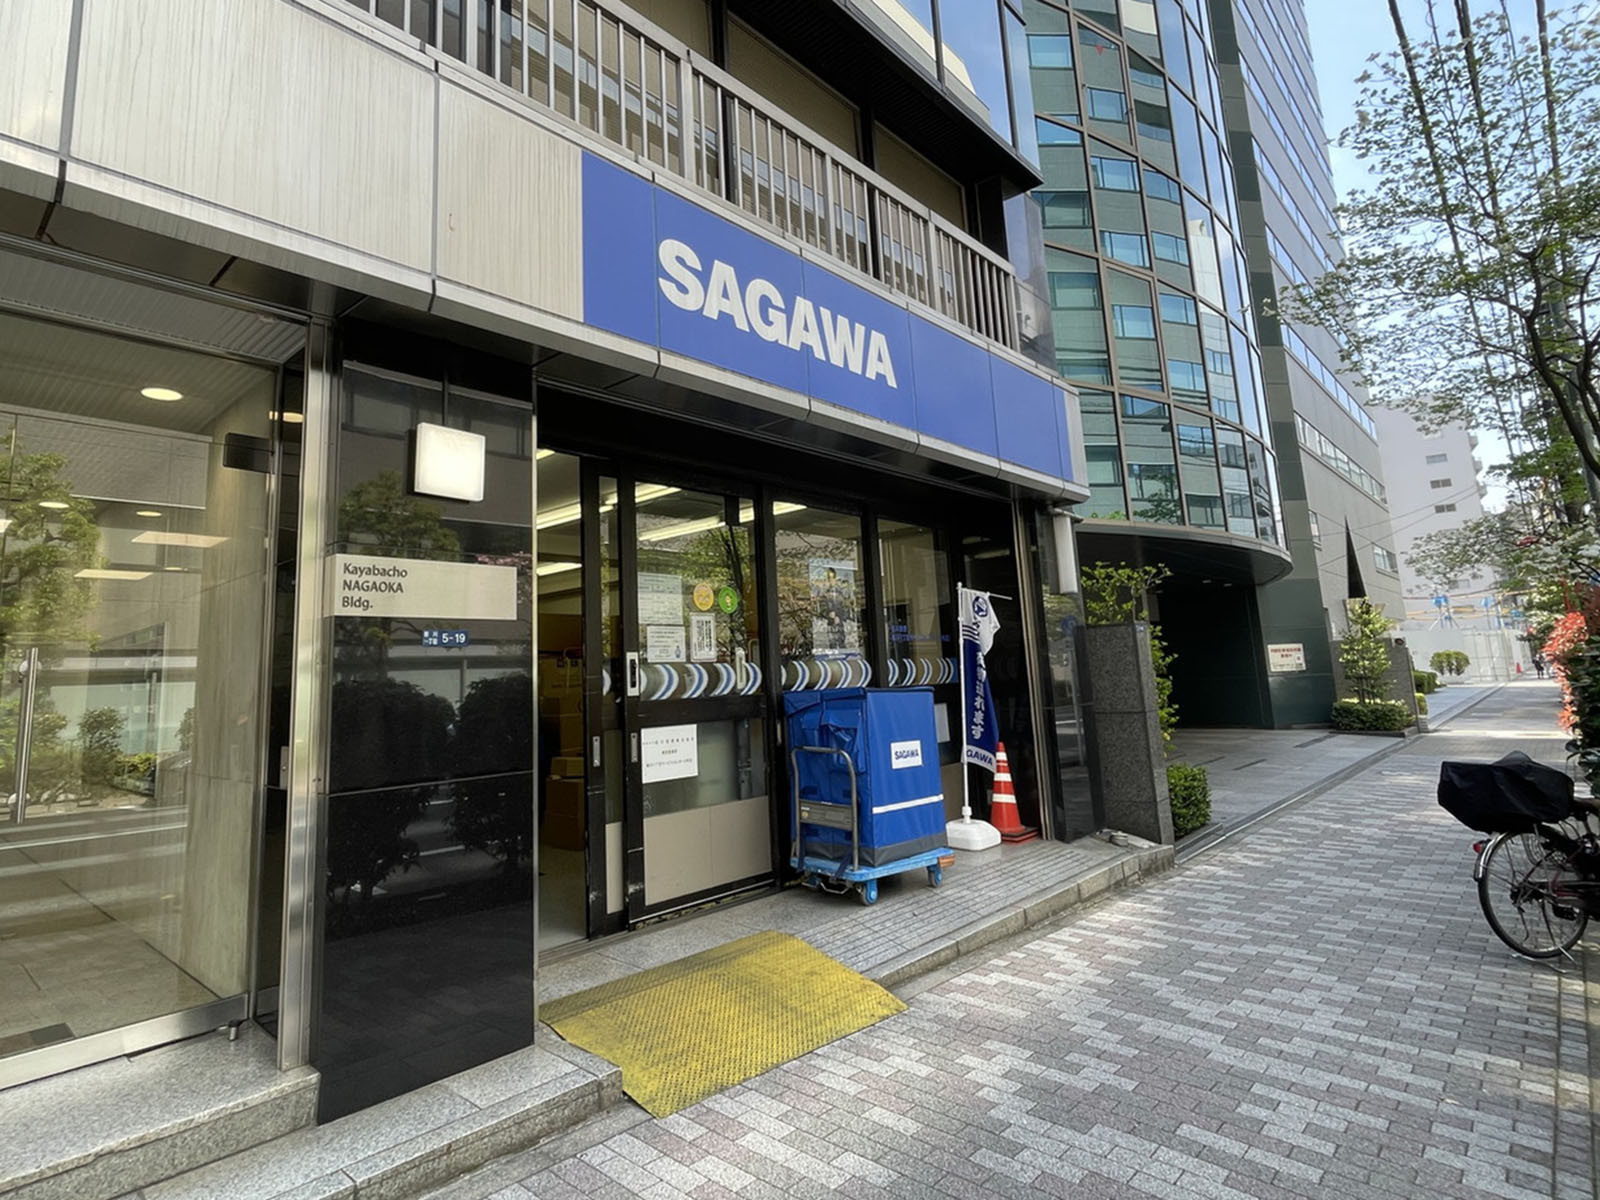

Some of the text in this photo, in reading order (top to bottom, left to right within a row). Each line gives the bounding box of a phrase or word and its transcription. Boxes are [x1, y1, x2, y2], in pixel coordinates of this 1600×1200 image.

[658, 238, 897, 389] SAGAWA
[343, 562, 408, 578] Kayabacho
[342, 579, 404, 594] NAGAOKA
[342, 595, 373, 611] Bldg.
[441, 632, 466, 643] 5-19
[894, 749, 919, 760] SAGAWA
[966, 749, 993, 766] GAWA
